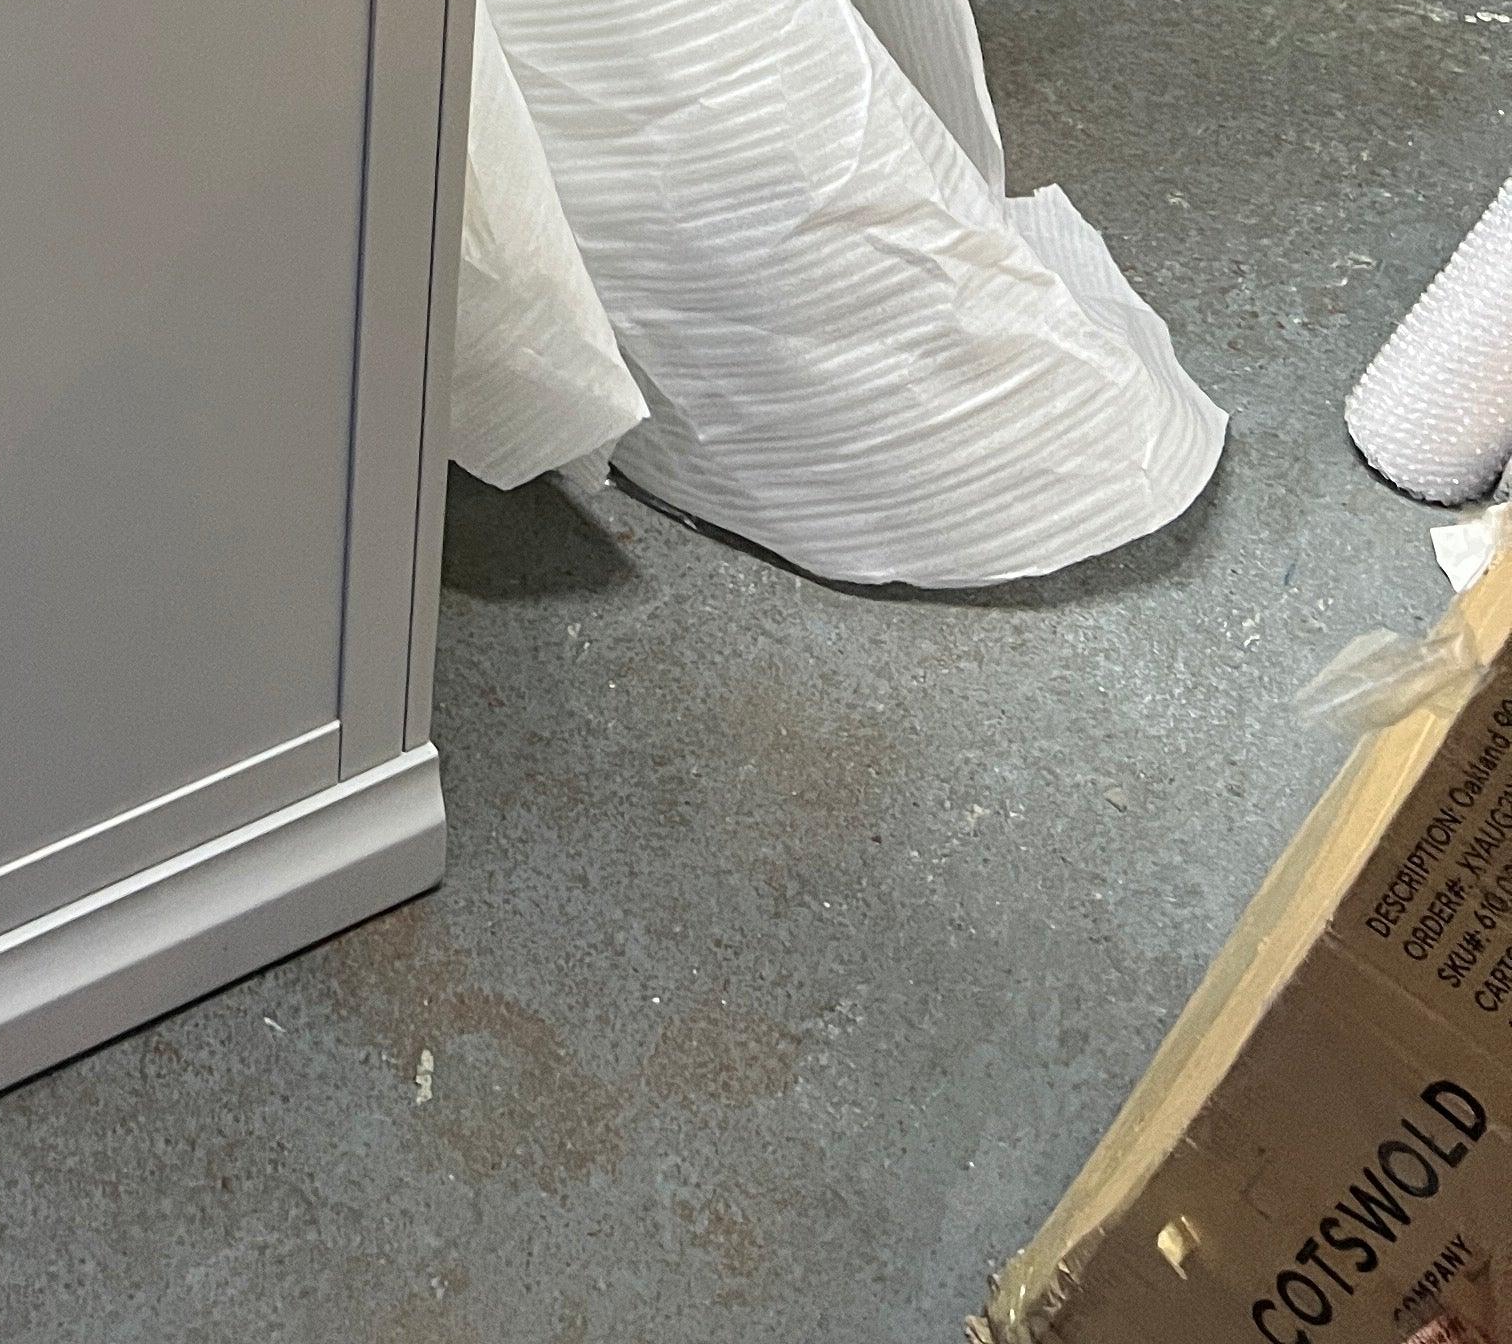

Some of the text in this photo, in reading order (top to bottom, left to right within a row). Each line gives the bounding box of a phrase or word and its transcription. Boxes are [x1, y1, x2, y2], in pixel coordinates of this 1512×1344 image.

[1366, 806, 1467, 938] DESCRIPTION:
[1449, 727, 1510, 807] Oakland
[1403, 875, 1474, 961] ORDER#:
[1438, 929, 1491, 988] SKU#:
[1475, 947, 1512, 1011] CART
[1252, 1080, 1487, 1344] COTSWOLD
